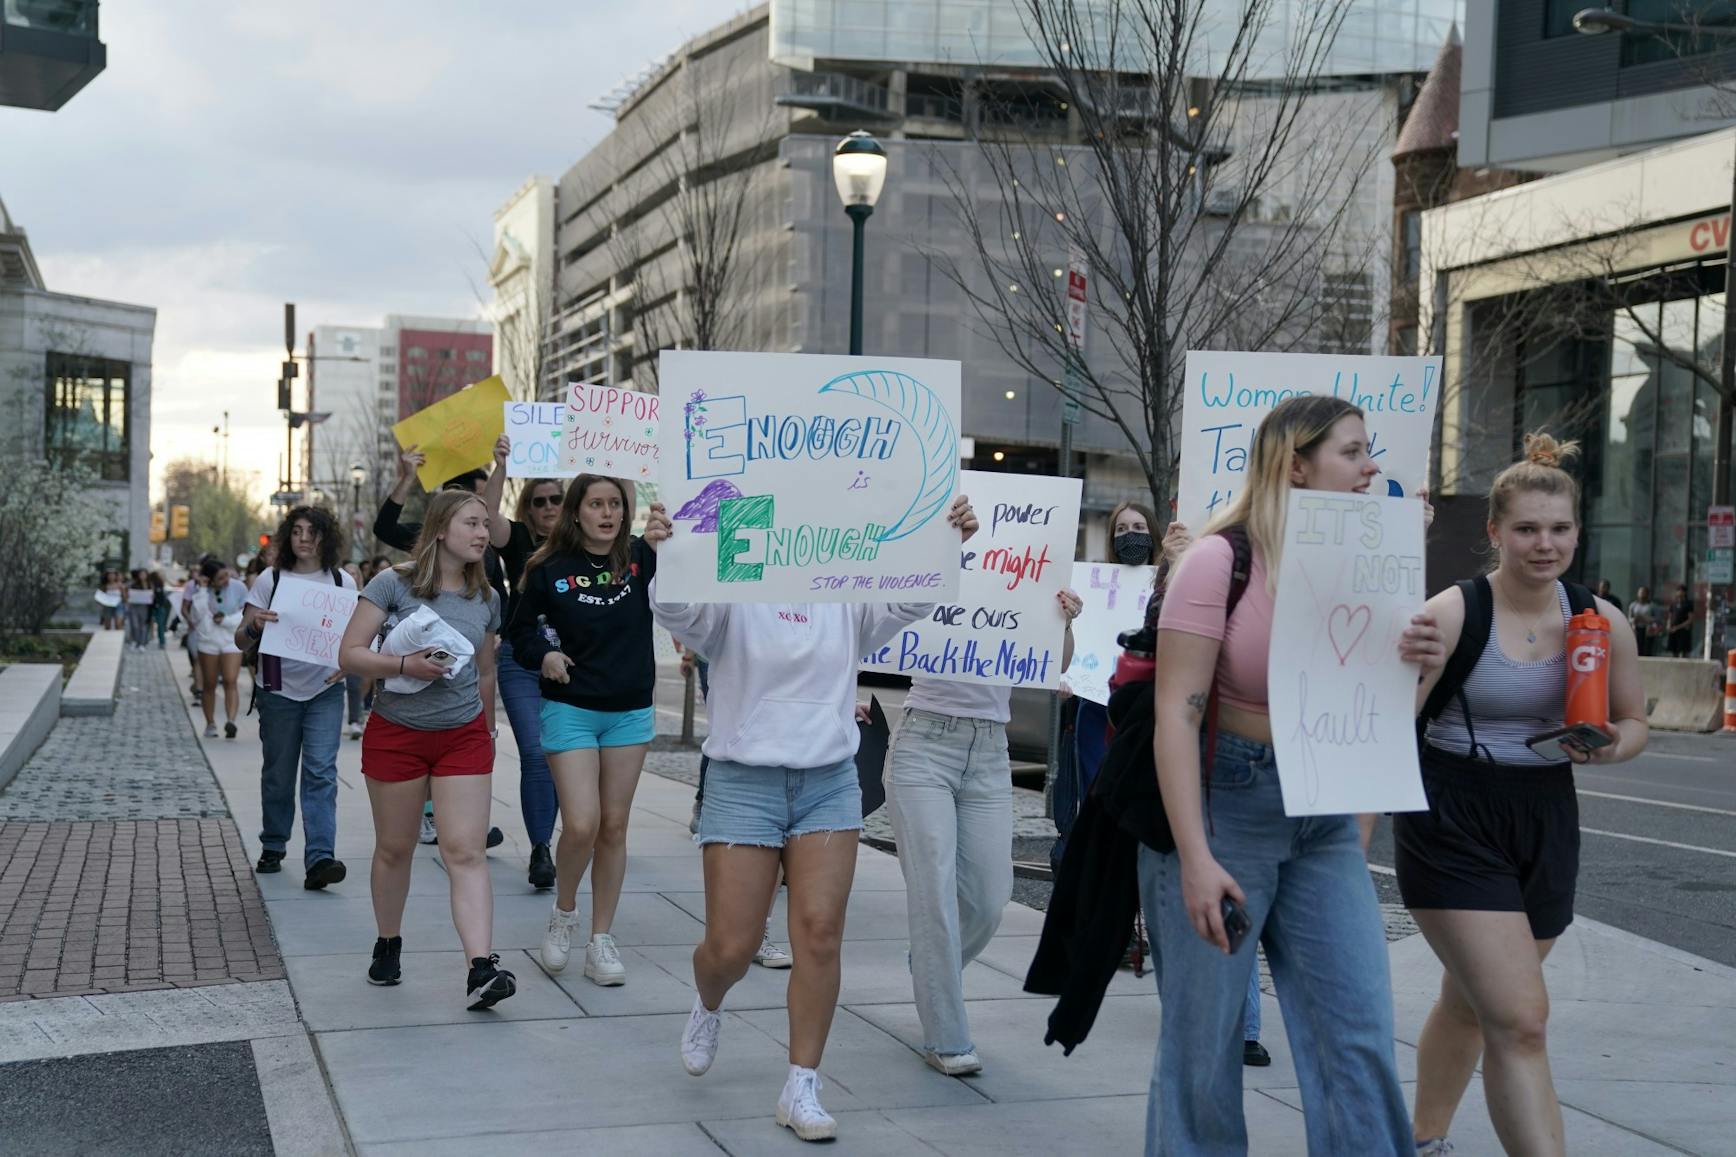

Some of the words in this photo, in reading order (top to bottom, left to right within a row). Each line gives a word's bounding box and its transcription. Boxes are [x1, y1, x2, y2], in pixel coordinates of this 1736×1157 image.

[1202, 372, 1312, 408] Wom
[1334, 366, 1435, 413] Unite!
[848, 470, 871, 491] is
[991, 502, 1060, 537] power
[1296, 496, 1382, 550] IT'S
[554, 575, 592, 593] SIG
[810, 575, 849, 591] STOP
[852, 575, 874, 590] THE
[1352, 554, 1421, 596] NOT
[321, 614, 334, 628] is
[933, 604, 965, 626] are
[900, 631, 958, 673] Back
[960, 639, 993, 678] the
[995, 639, 1053, 685] Night
[1291, 670, 1380, 807] fault
